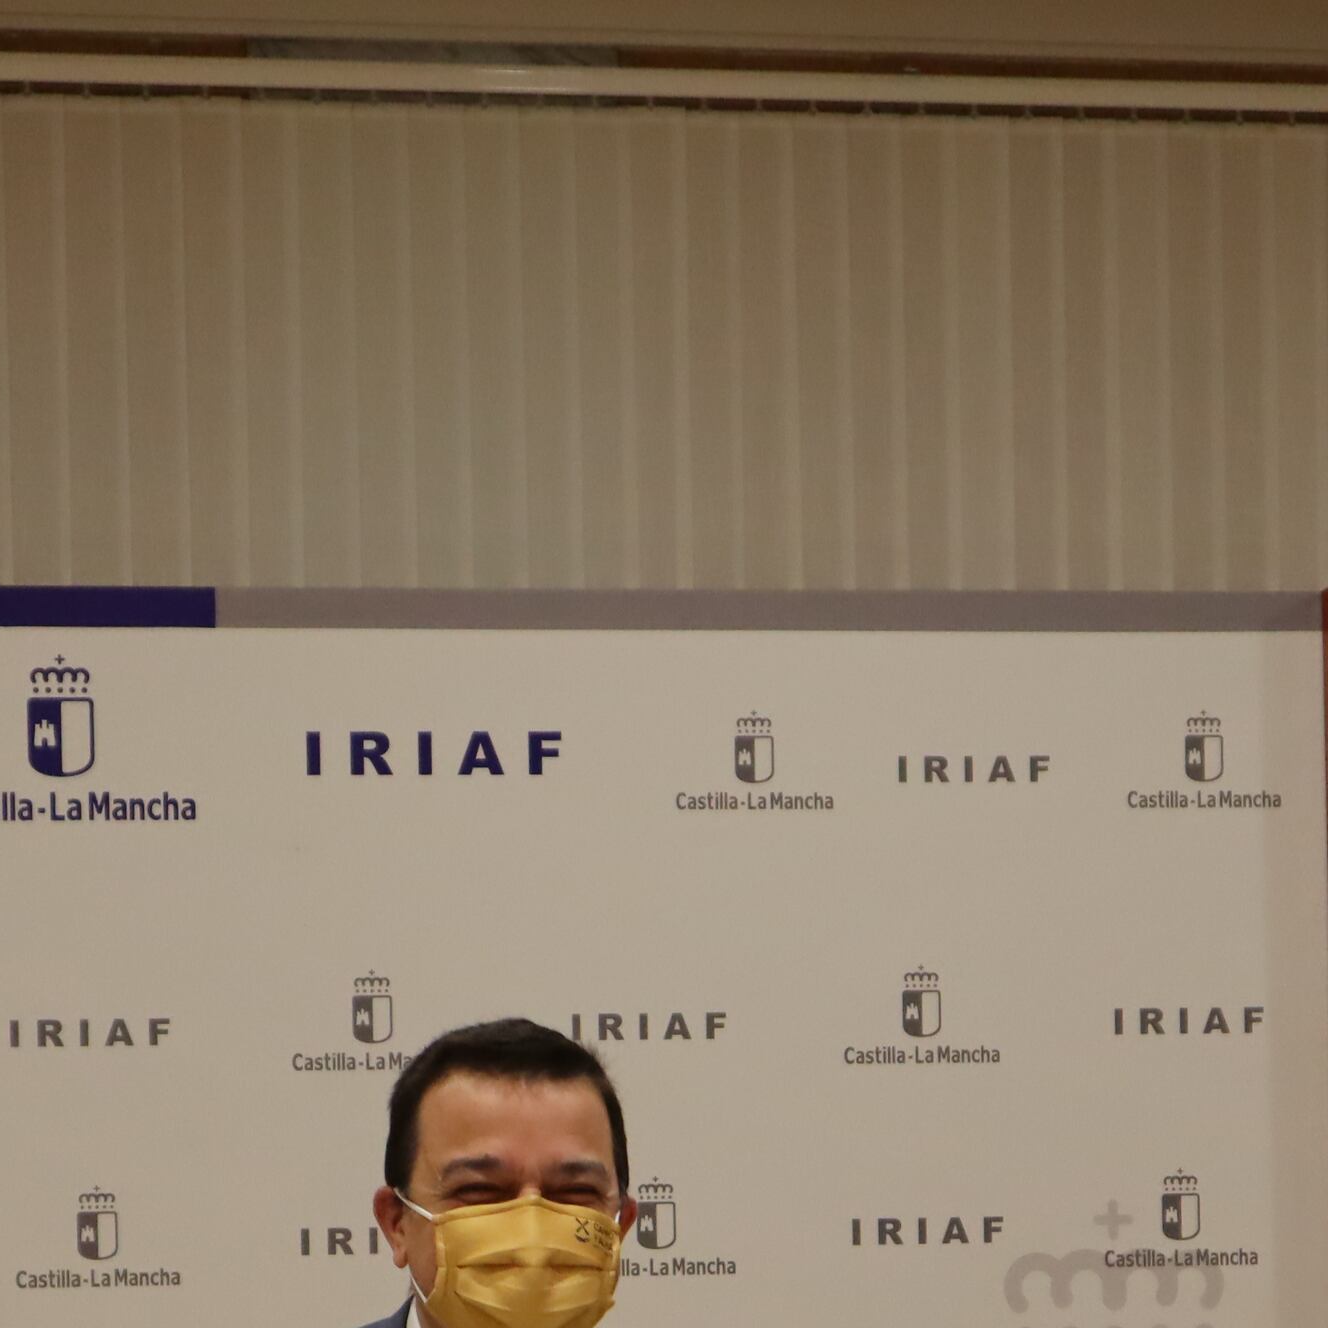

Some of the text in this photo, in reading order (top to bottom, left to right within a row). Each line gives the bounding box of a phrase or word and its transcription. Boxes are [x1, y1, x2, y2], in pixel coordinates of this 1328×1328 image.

[307, 732, 561, 775] IRIAF
[898, 756, 1049, 783] IRIAF
[89, 792, 196, 820] Mancha
[676, 792, 833, 810] Castilla-La Mancha
[1128, 790, 1281, 808] Castilla-La Mancha
[10, 1018, 170, 1047] IRIAF
[571, 1013, 727, 1041] IRIAF
[1114, 1007, 1264, 1035] IRIAF
[293, 1053, 385, 1070] Castilla-La
[844, 1045, 1000, 1064] Castilla-La Mancha
[300, 1228, 378, 1256] IRI
[852, 1217, 1003, 1245] IRIAF
[621, 1258, 736, 1277] lla-La Mancha
[1104, 1248, 1259, 1269] Castilla-La Mancha
[16, 1268, 180, 1288] Castilla-La Mancha
